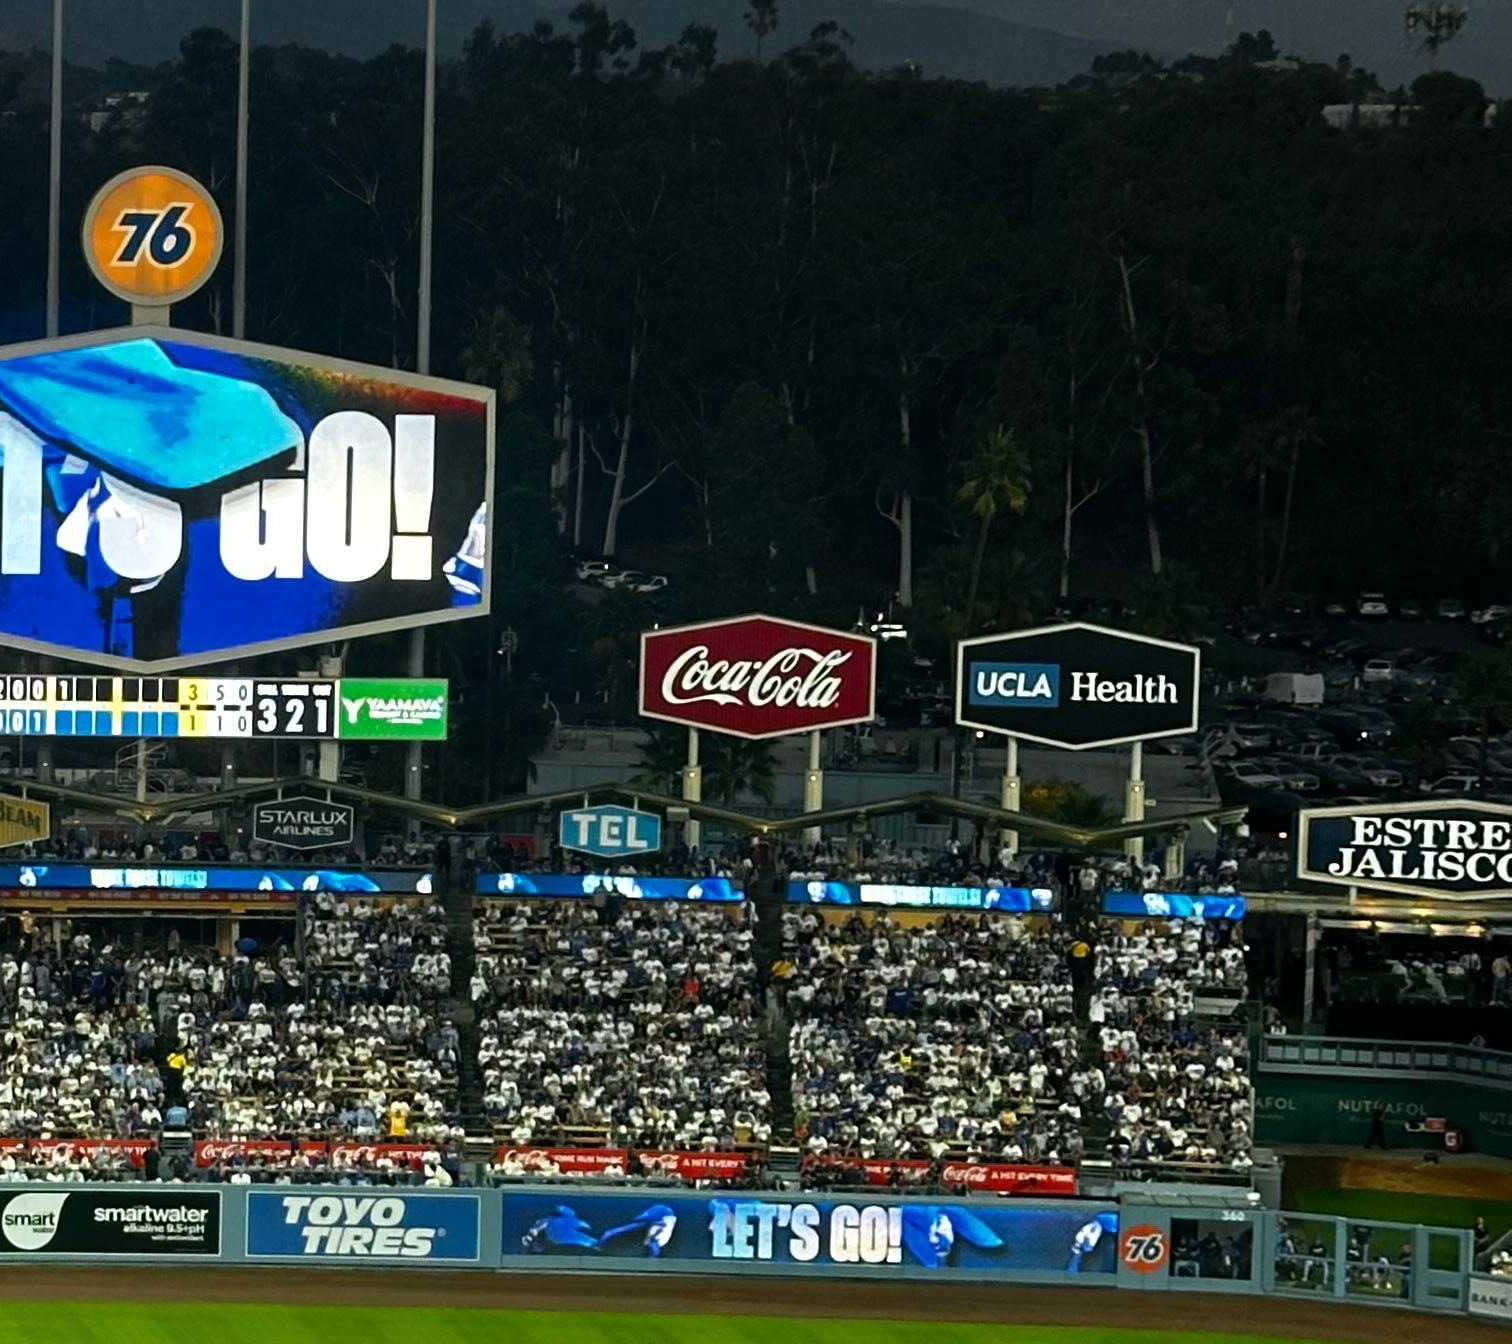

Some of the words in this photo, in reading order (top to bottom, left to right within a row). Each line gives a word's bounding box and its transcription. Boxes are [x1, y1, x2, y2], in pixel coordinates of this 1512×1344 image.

[110, 202, 196, 267] 76
[12, 679, 25, 700] 0
[32, 679, 45, 700] 0
[59, 680, 69, 701] 1
[188, 684, 198, 701] 3
[217, 685, 225, 701] 5
[239, 685, 248, 701] 0
[661, 645, 853, 708] Coca-Cola
[976, 671, 1053, 698] UCLA
[1070, 672, 1178, 703] Health
[12, 711, 24, 733] 0
[33, 711, 42, 733] 1
[190, 715, 196, 731] 1
[238, 716, 247, 732] 0
[257, 699, 277, 733] 3
[285, 699, 305, 733] 2
[315, 699, 327, 733] 1
[258, 810, 348, 825] STARLUX
[272, 825, 335, 836] AIRLINES
[572, 813, 648, 849] TEL
[1350, 816, 1512, 850] ESTRE
[4, 1211, 56, 1226] smart
[94, 1205, 209, 1223] smartwater
[282, 1196, 406, 1226] TOYO
[301, 1226, 436, 1256] TIRES
[710, 1203, 820, 1261] LET'S
[830, 1205, 902, 1263] GO!
[1125, 1234, 1164, 1263] 76
